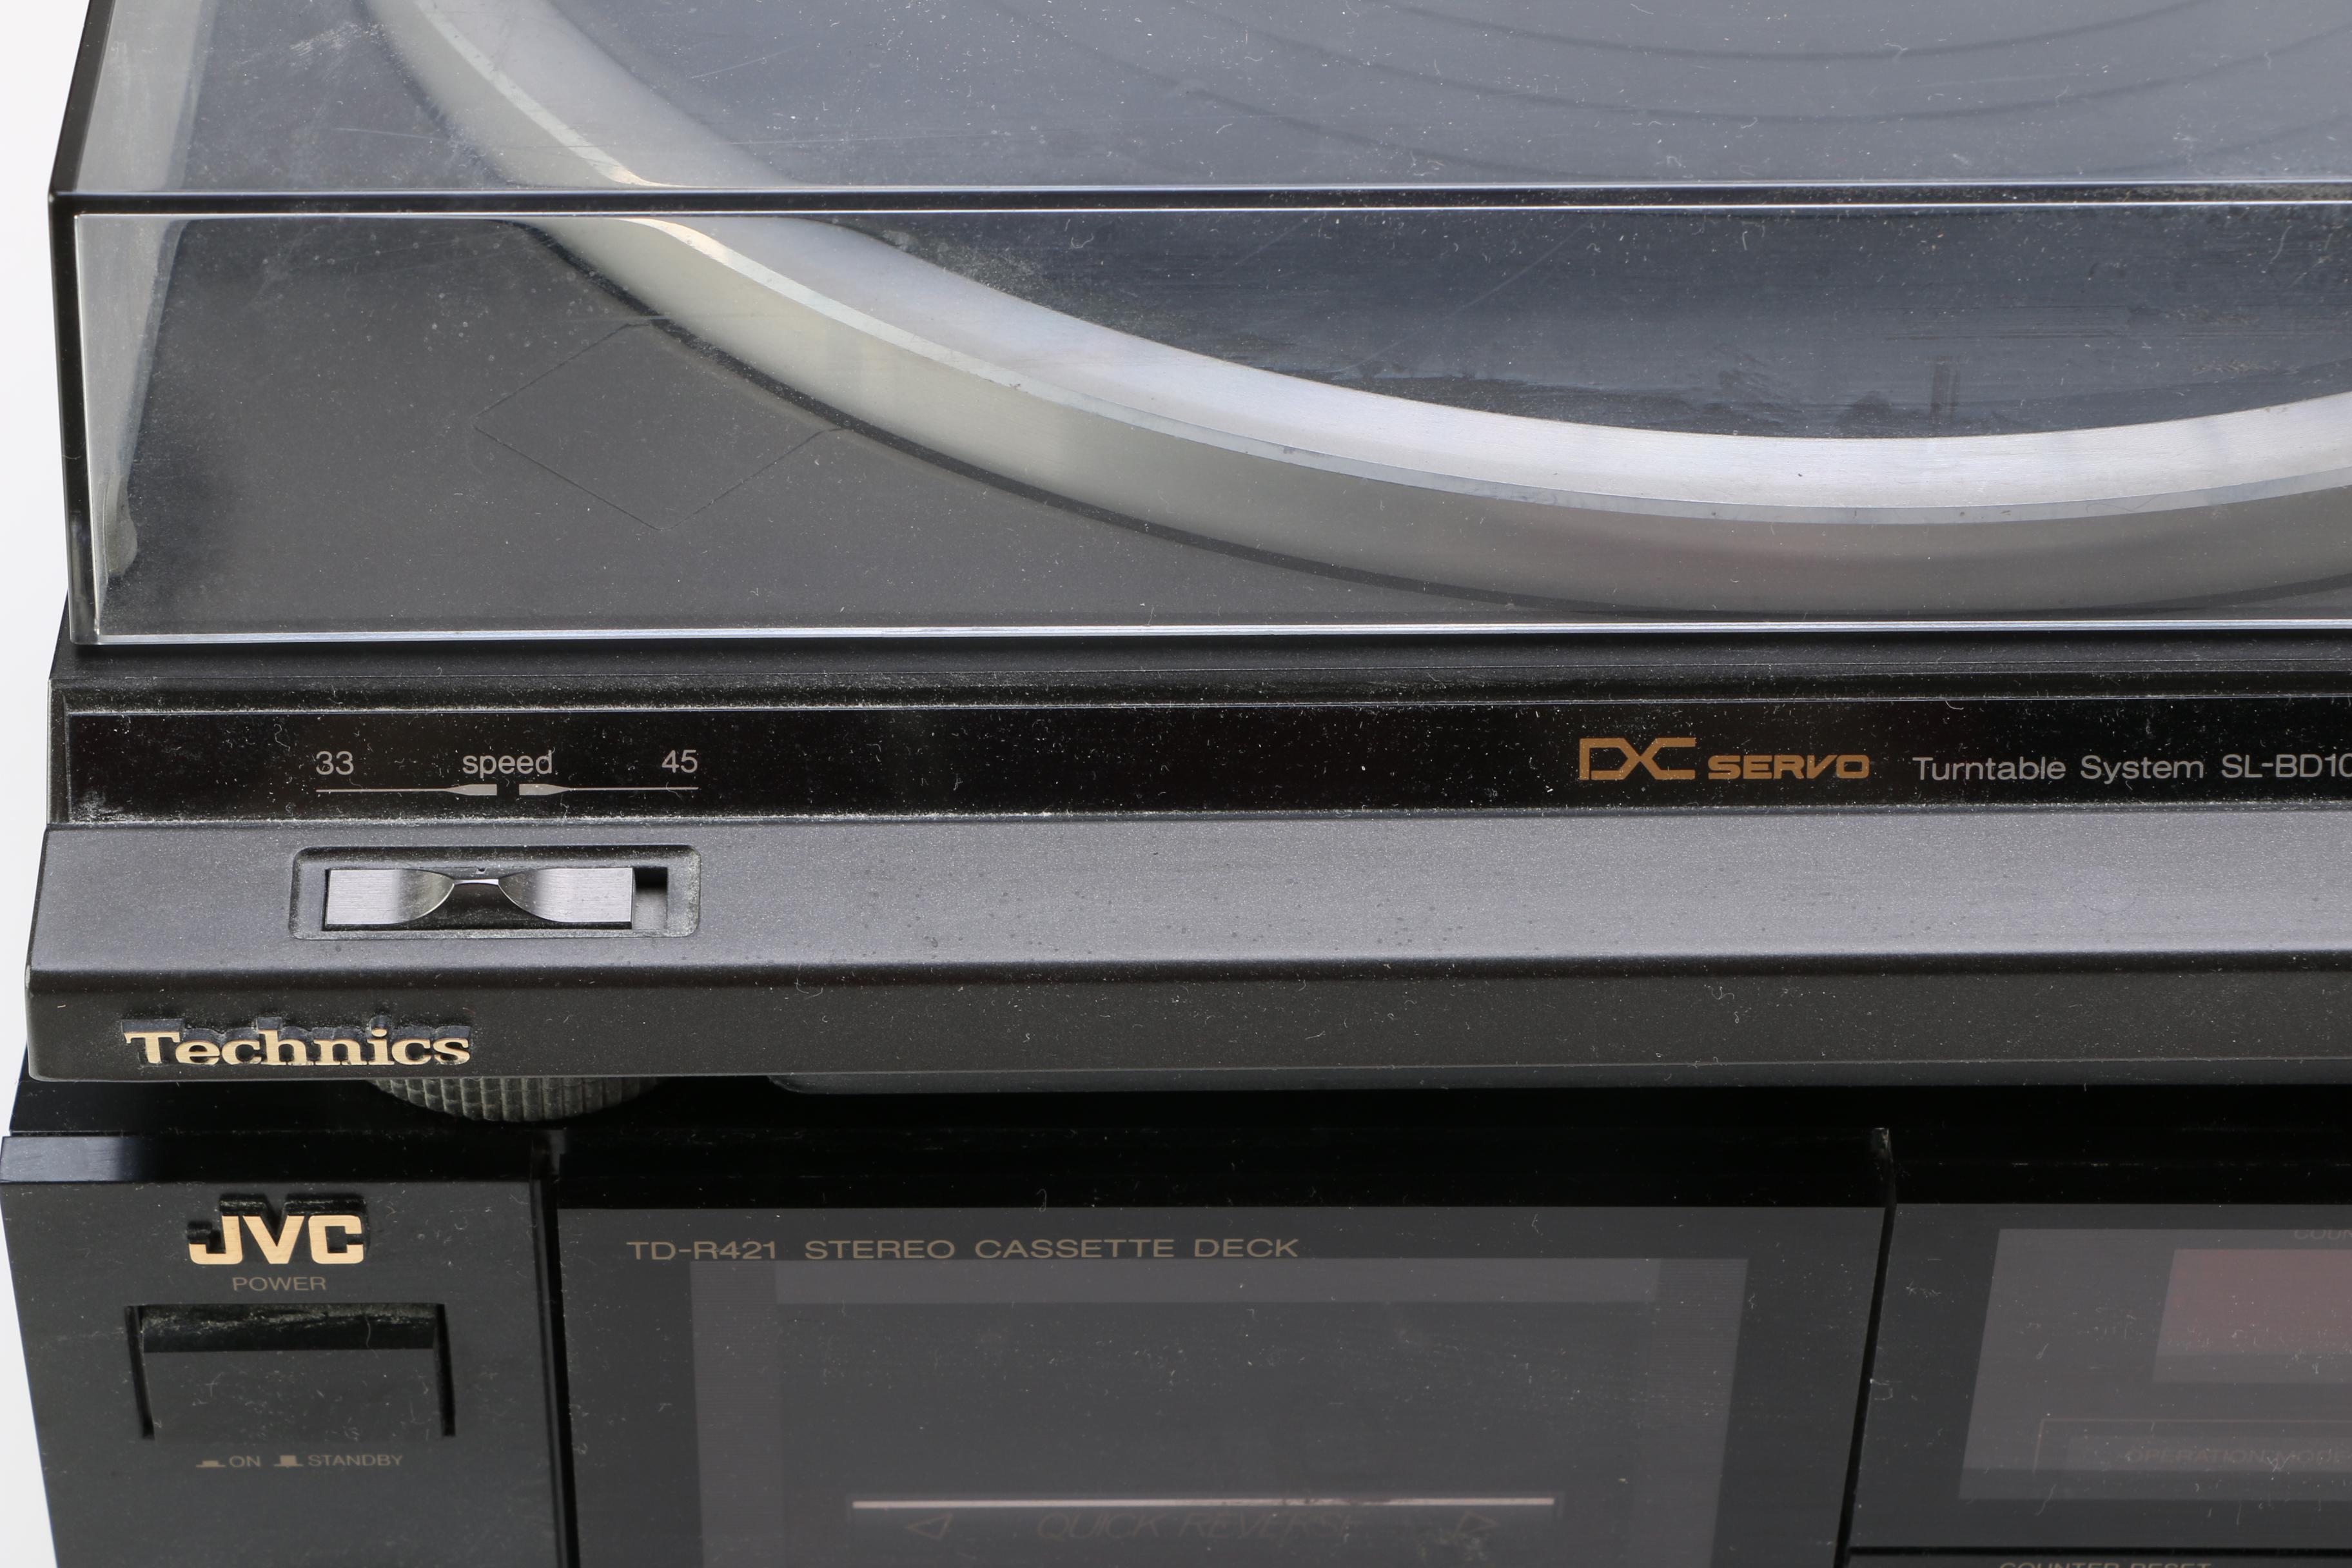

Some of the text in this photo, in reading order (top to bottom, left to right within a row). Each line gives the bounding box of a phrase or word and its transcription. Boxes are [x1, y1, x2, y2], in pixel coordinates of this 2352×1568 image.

[316, 750, 354, 776] 33
[462, 747, 555, 779] speed
[662, 749, 698, 774] 45
[1707, 754, 1870, 781] SERVO
[1912, 752, 2352, 785] Turntable System SL-BD10
[123, 1027, 471, 1066] Technics
[188, 1214, 364, 1265] JVC
[626, 1238, 1298, 1260] TD-R421 STEREO CASSETTE DECK
[231, 1277, 326, 1291] POWER
[229, 1454, 402, 1468] ON STANDBY
[1037, 1512, 1168, 1542] QUICK
